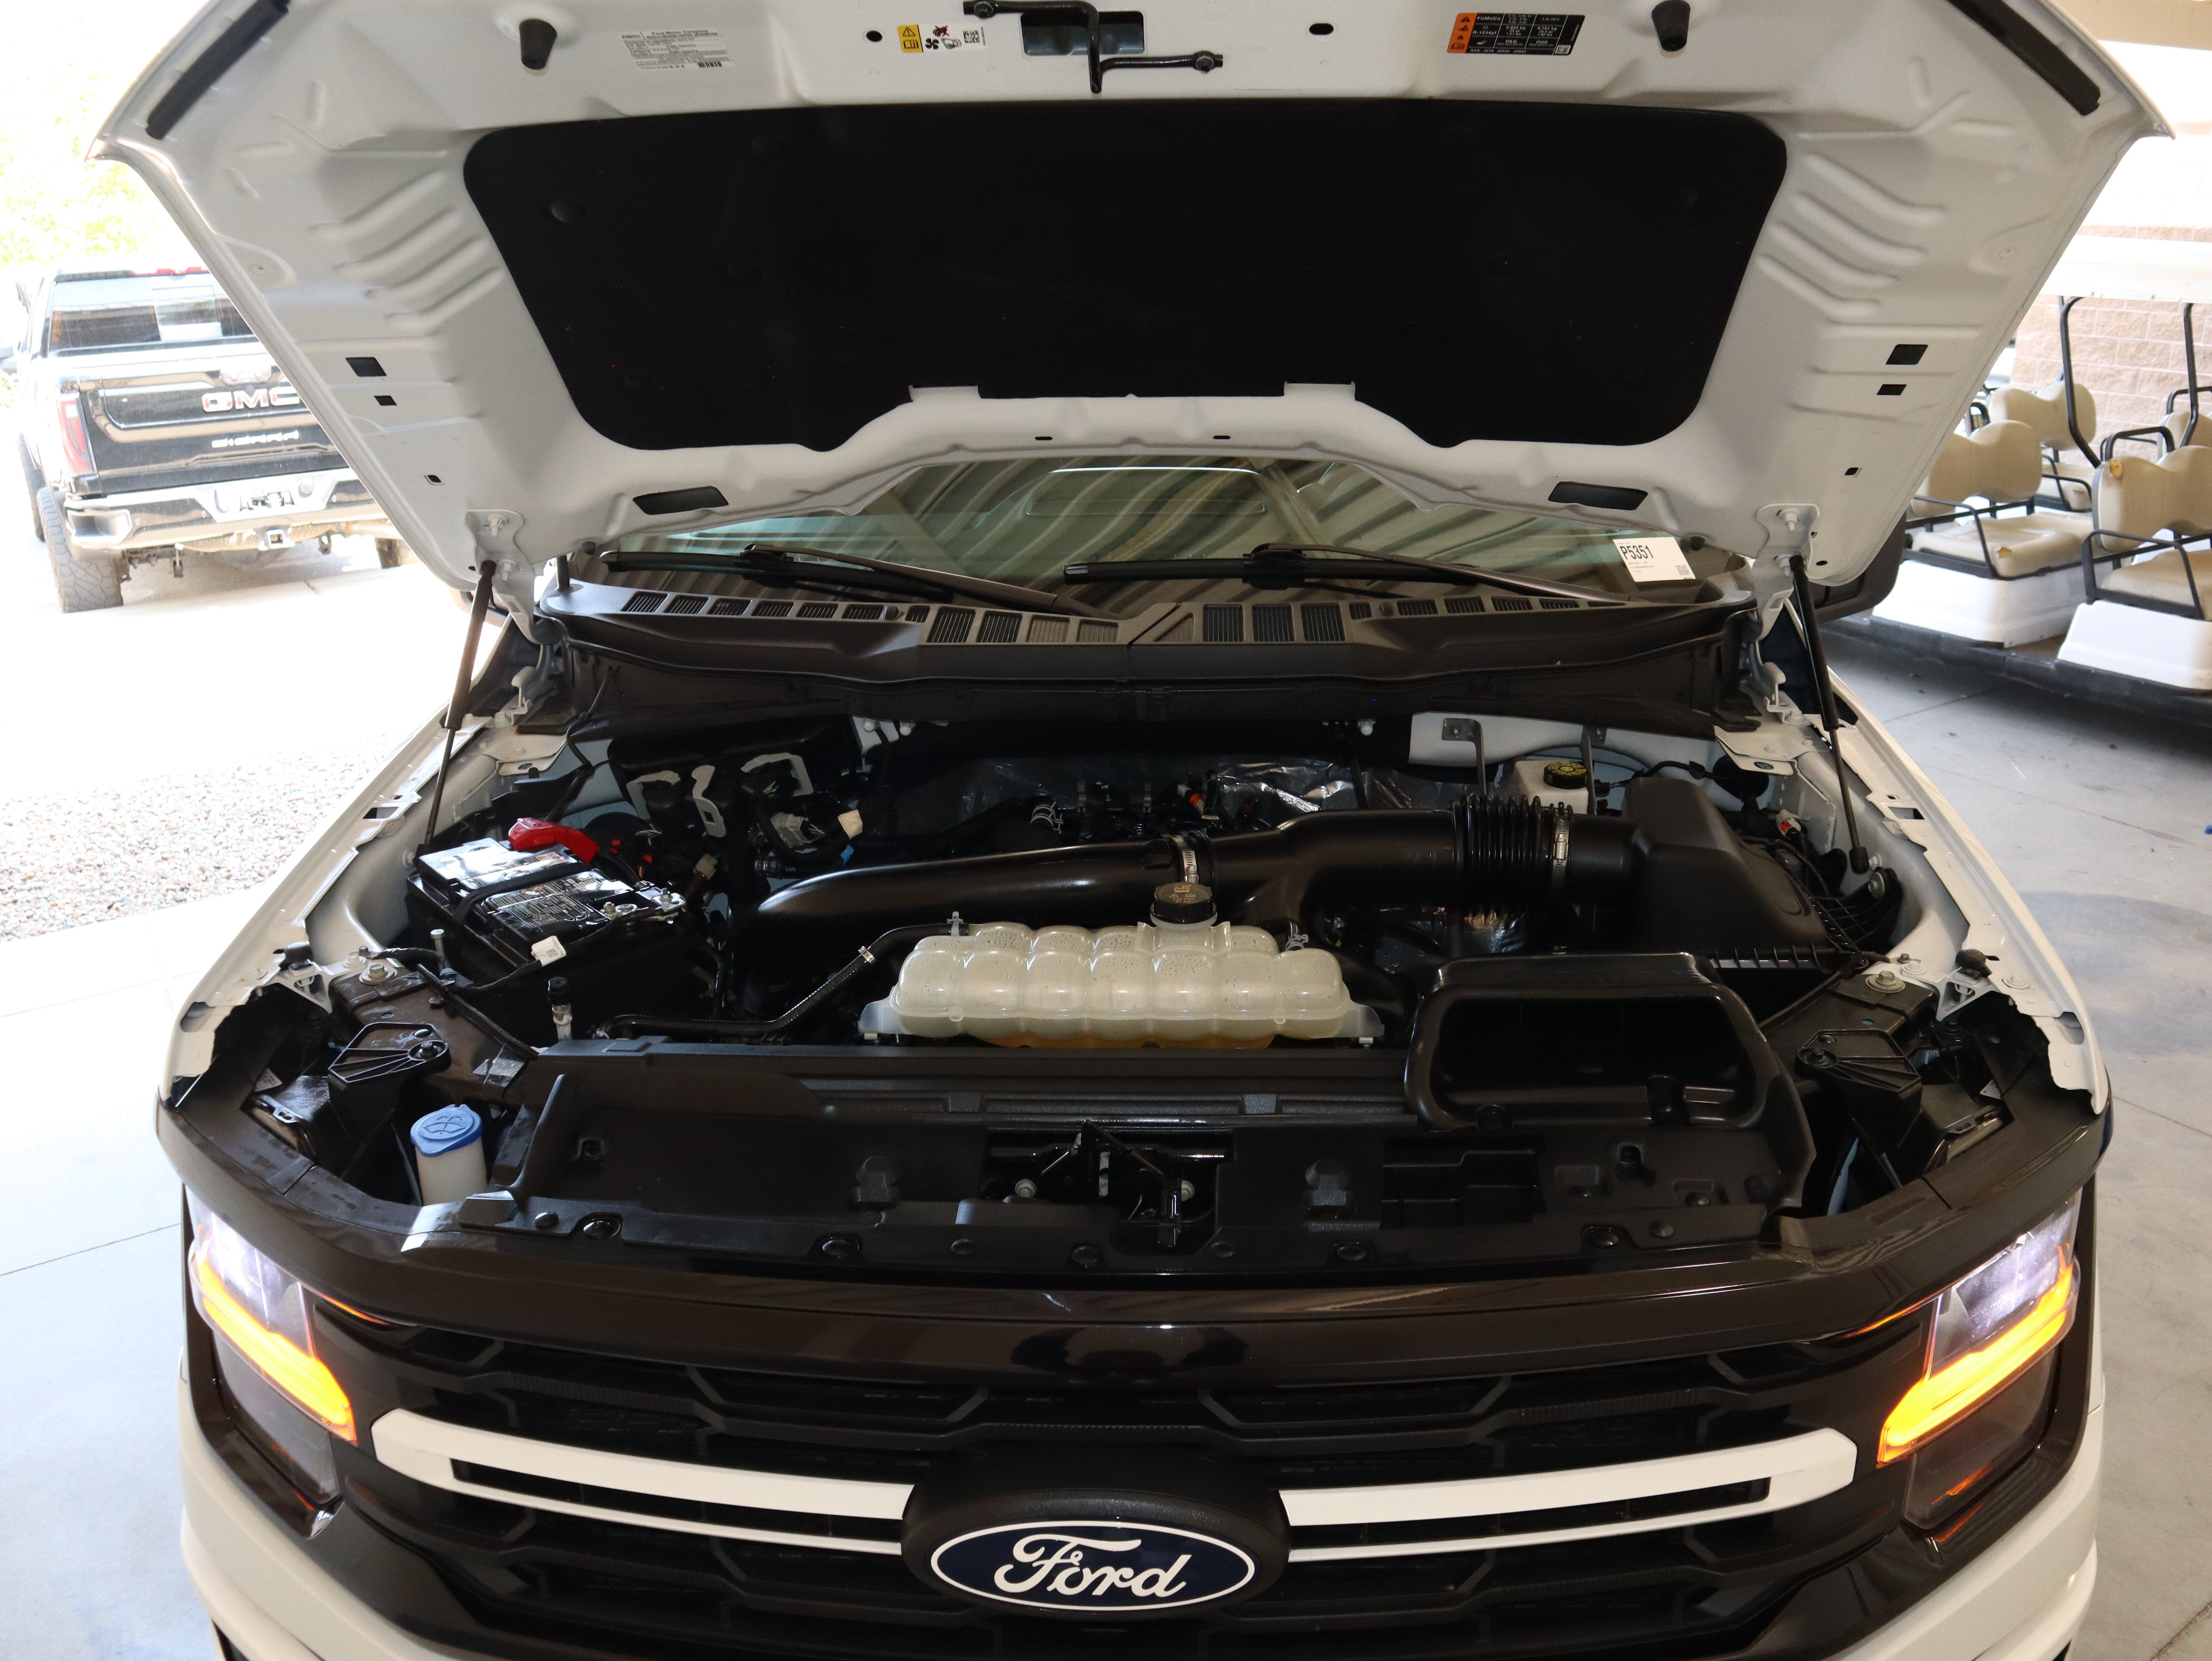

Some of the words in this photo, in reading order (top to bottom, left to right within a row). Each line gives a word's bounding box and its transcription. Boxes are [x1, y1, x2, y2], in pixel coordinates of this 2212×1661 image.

[202, 386, 300, 412] GMC
[1620, 545, 1654, 559] P5351
[994, 1534, 1192, 1597] Ford
